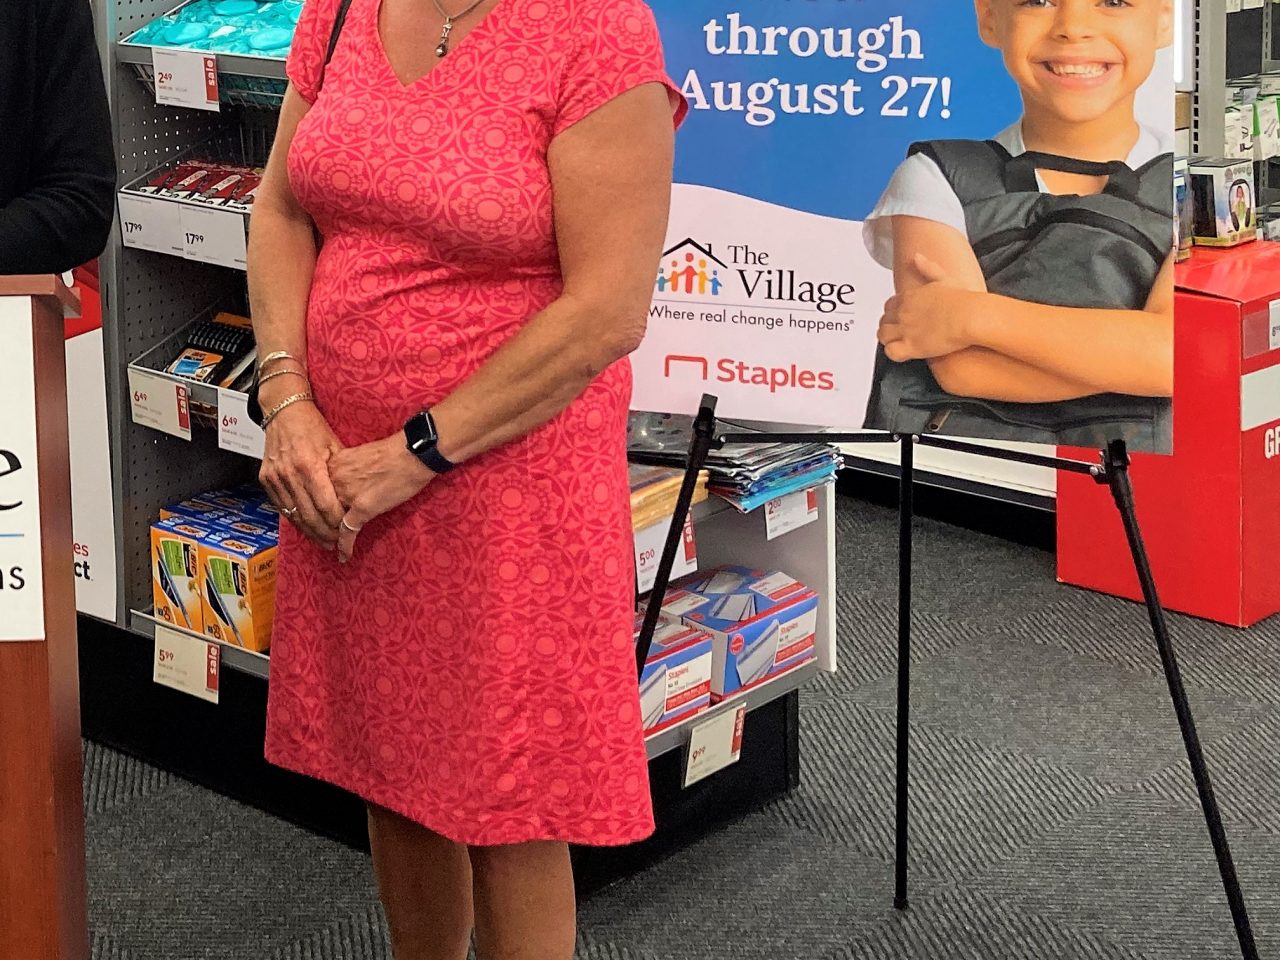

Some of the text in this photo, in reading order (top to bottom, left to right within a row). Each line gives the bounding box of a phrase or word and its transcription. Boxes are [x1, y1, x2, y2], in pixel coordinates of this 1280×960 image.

[703, 12, 924, 73] through
[205, 59, 216, 86] sale
[681, 69, 952, 126] August 27!
[727, 244, 769, 266] The
[736, 268, 855, 313] Village
[649, 305, 695, 320] Where
[700, 308, 727, 323] real
[731, 311, 784, 330] change
[716, 357, 834, 393] Staples
[209, 647, 218, 674] sale
